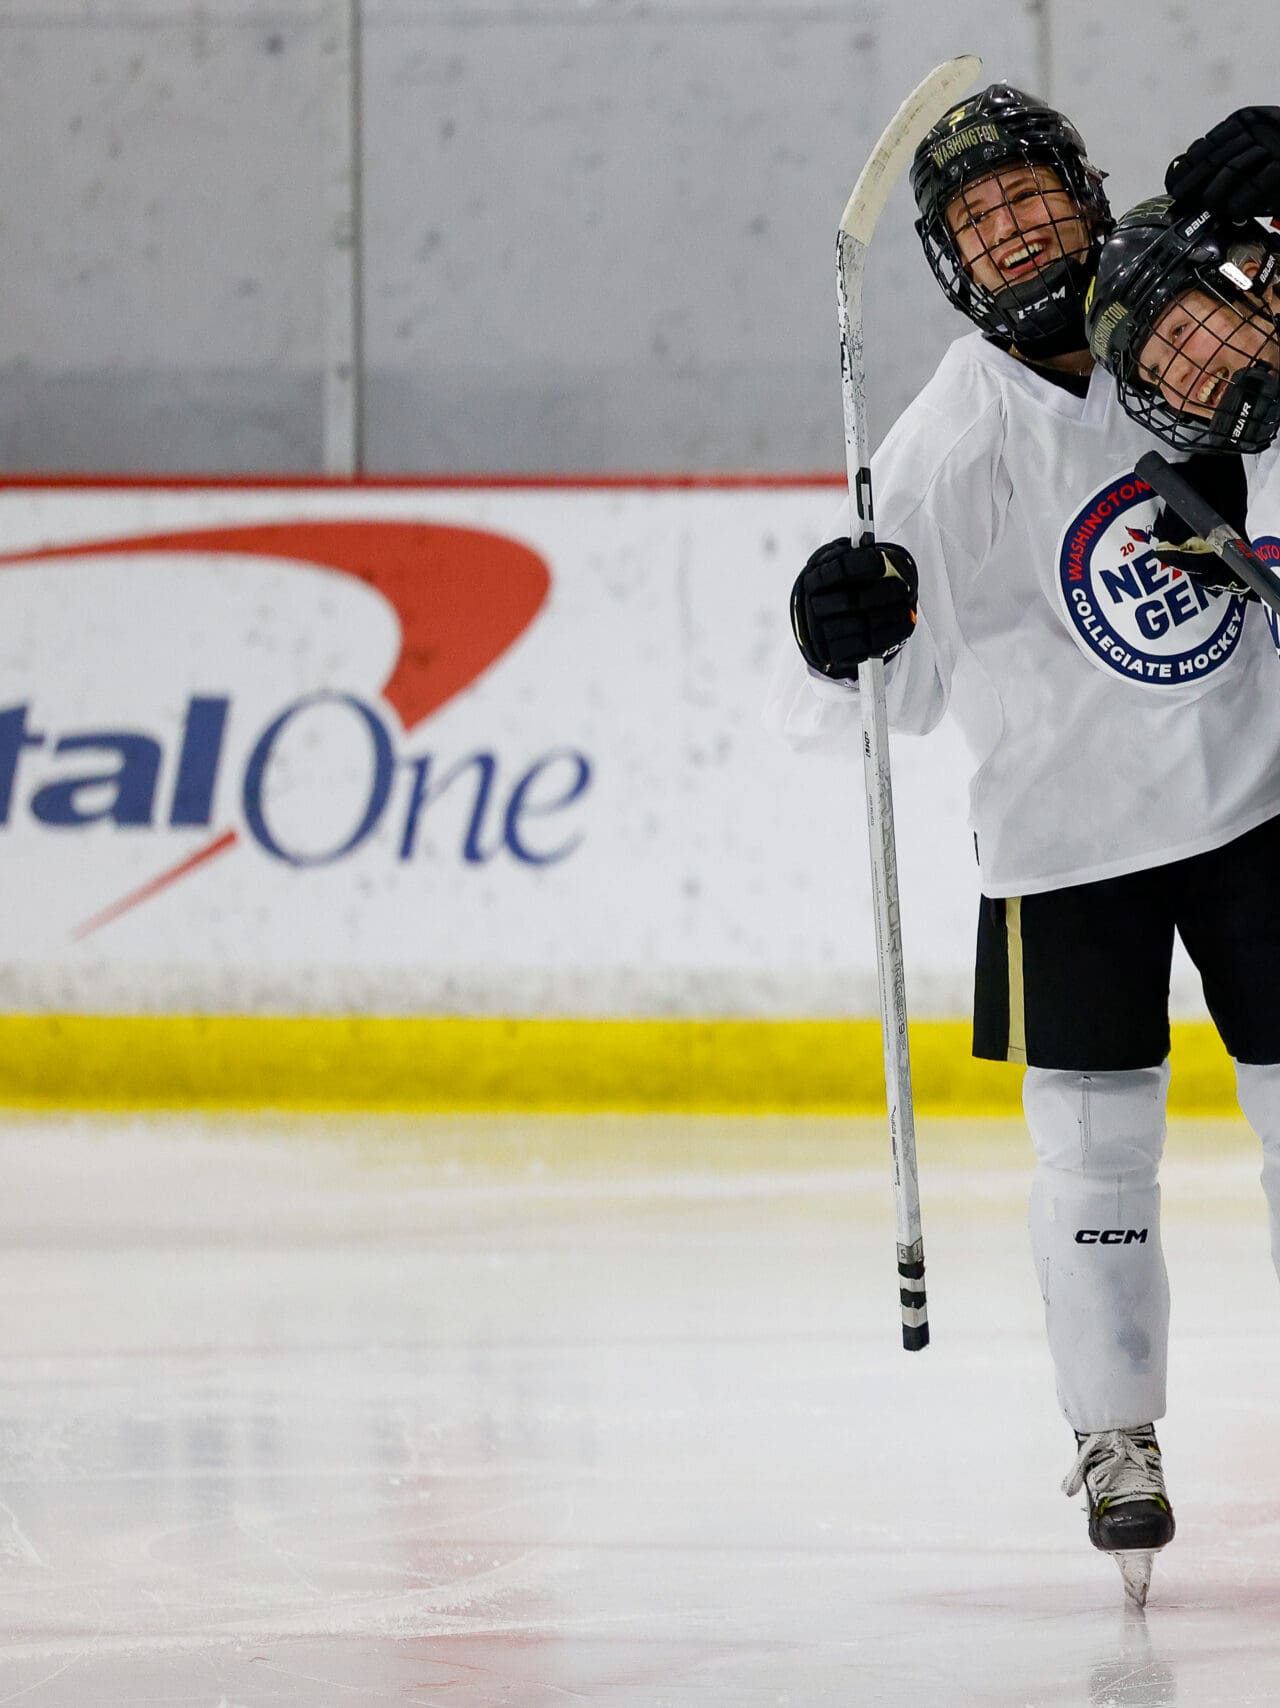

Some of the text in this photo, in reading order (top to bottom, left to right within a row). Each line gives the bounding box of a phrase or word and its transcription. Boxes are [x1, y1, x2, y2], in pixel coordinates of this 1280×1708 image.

[933, 124, 1000, 169] WASHINGTON
[1068, 478, 1151, 581] WASHINGTON
[1120, 542, 1136, 558] 20
[1072, 588, 1172, 678] COLLEGIATE
[1179, 610, 1243, 677] HOCKEY
[1074, 1228, 1149, 1245] CCM
